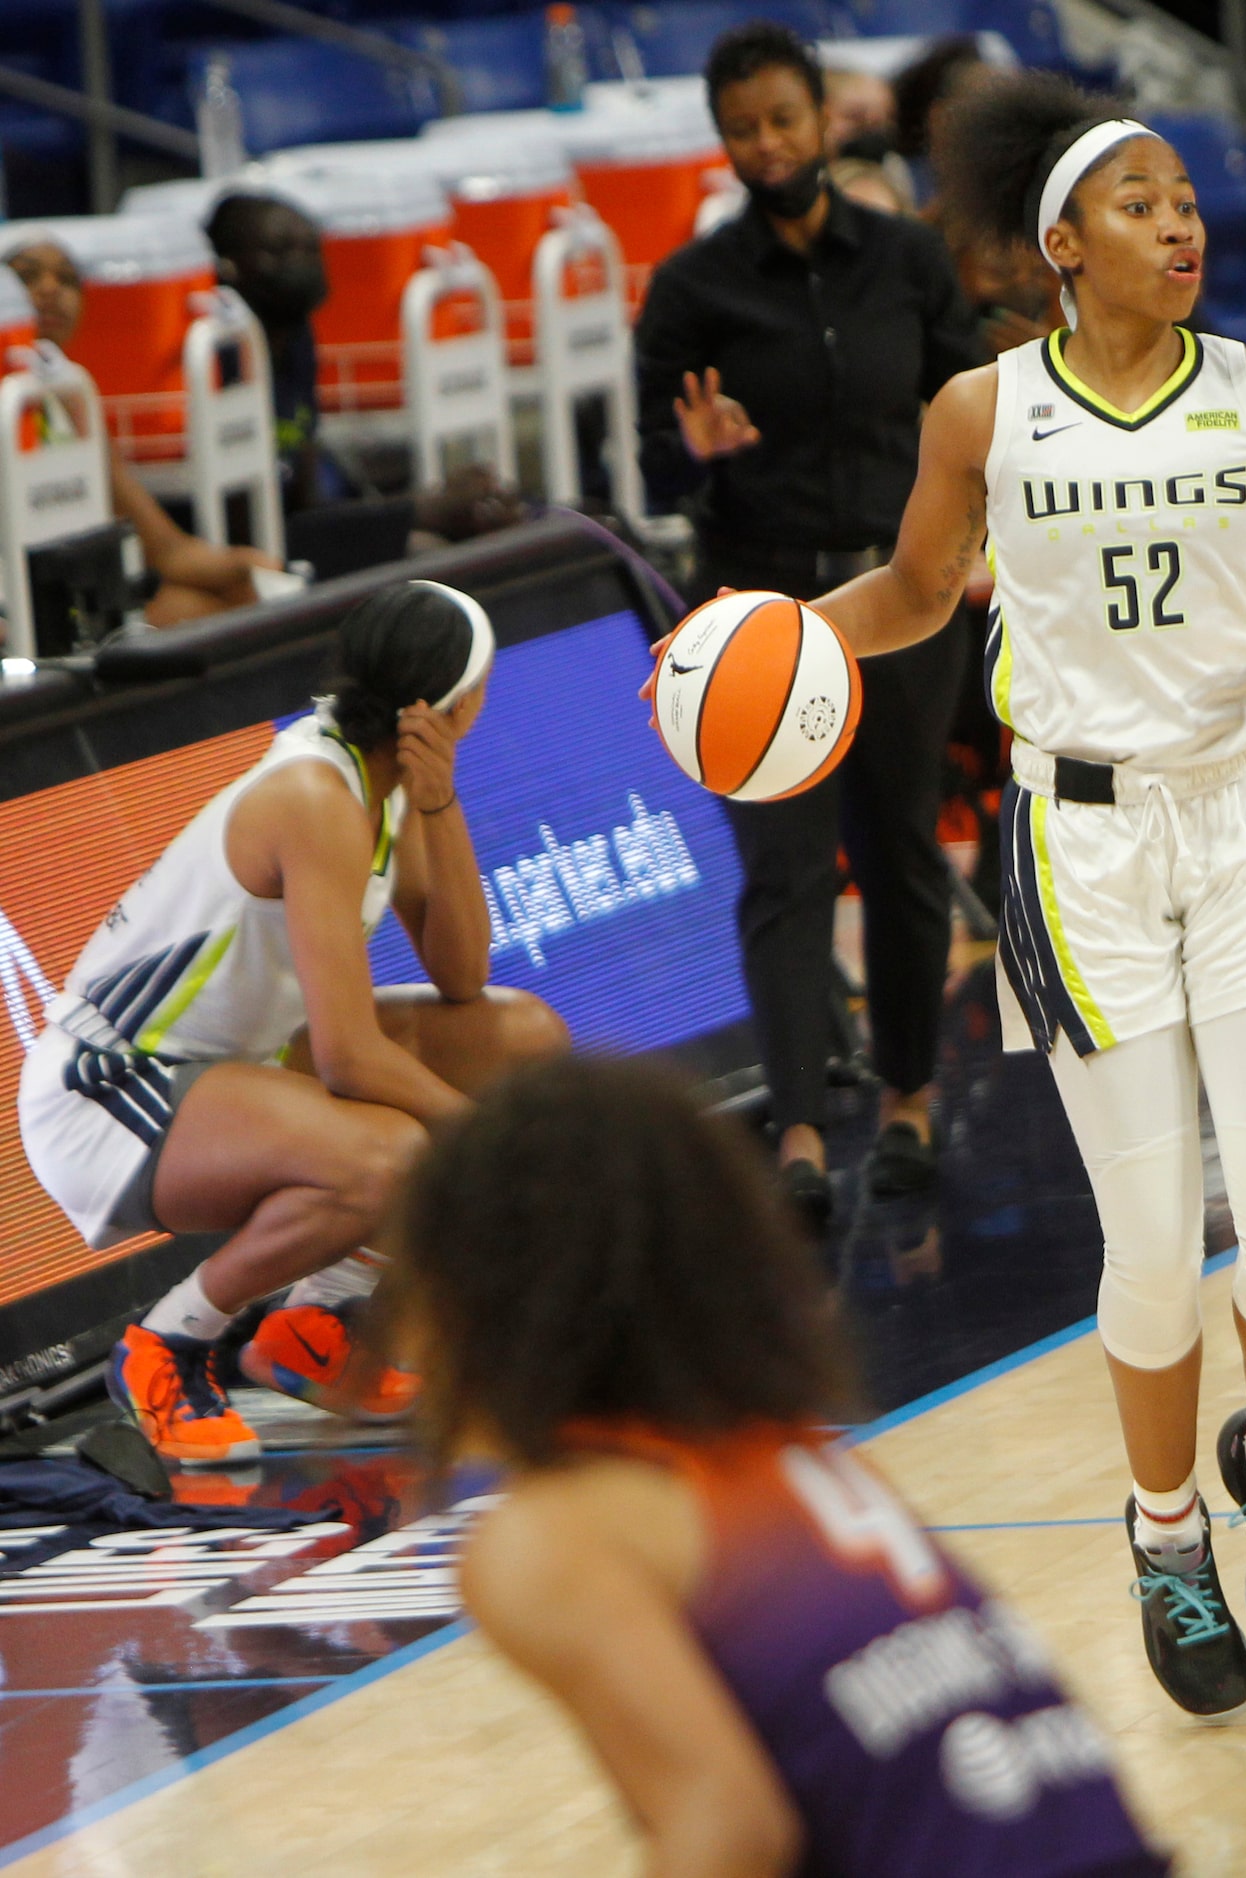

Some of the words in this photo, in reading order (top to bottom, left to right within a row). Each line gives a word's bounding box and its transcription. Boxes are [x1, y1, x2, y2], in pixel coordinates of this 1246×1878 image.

[1187, 411, 1238, 421] AMERICAN
[1196, 419, 1238, 428] FIDELITY
[1047, 516, 1230, 541] DALLAS
[1099, 540, 1186, 631] 52
[784, 1446, 944, 1594] 4
